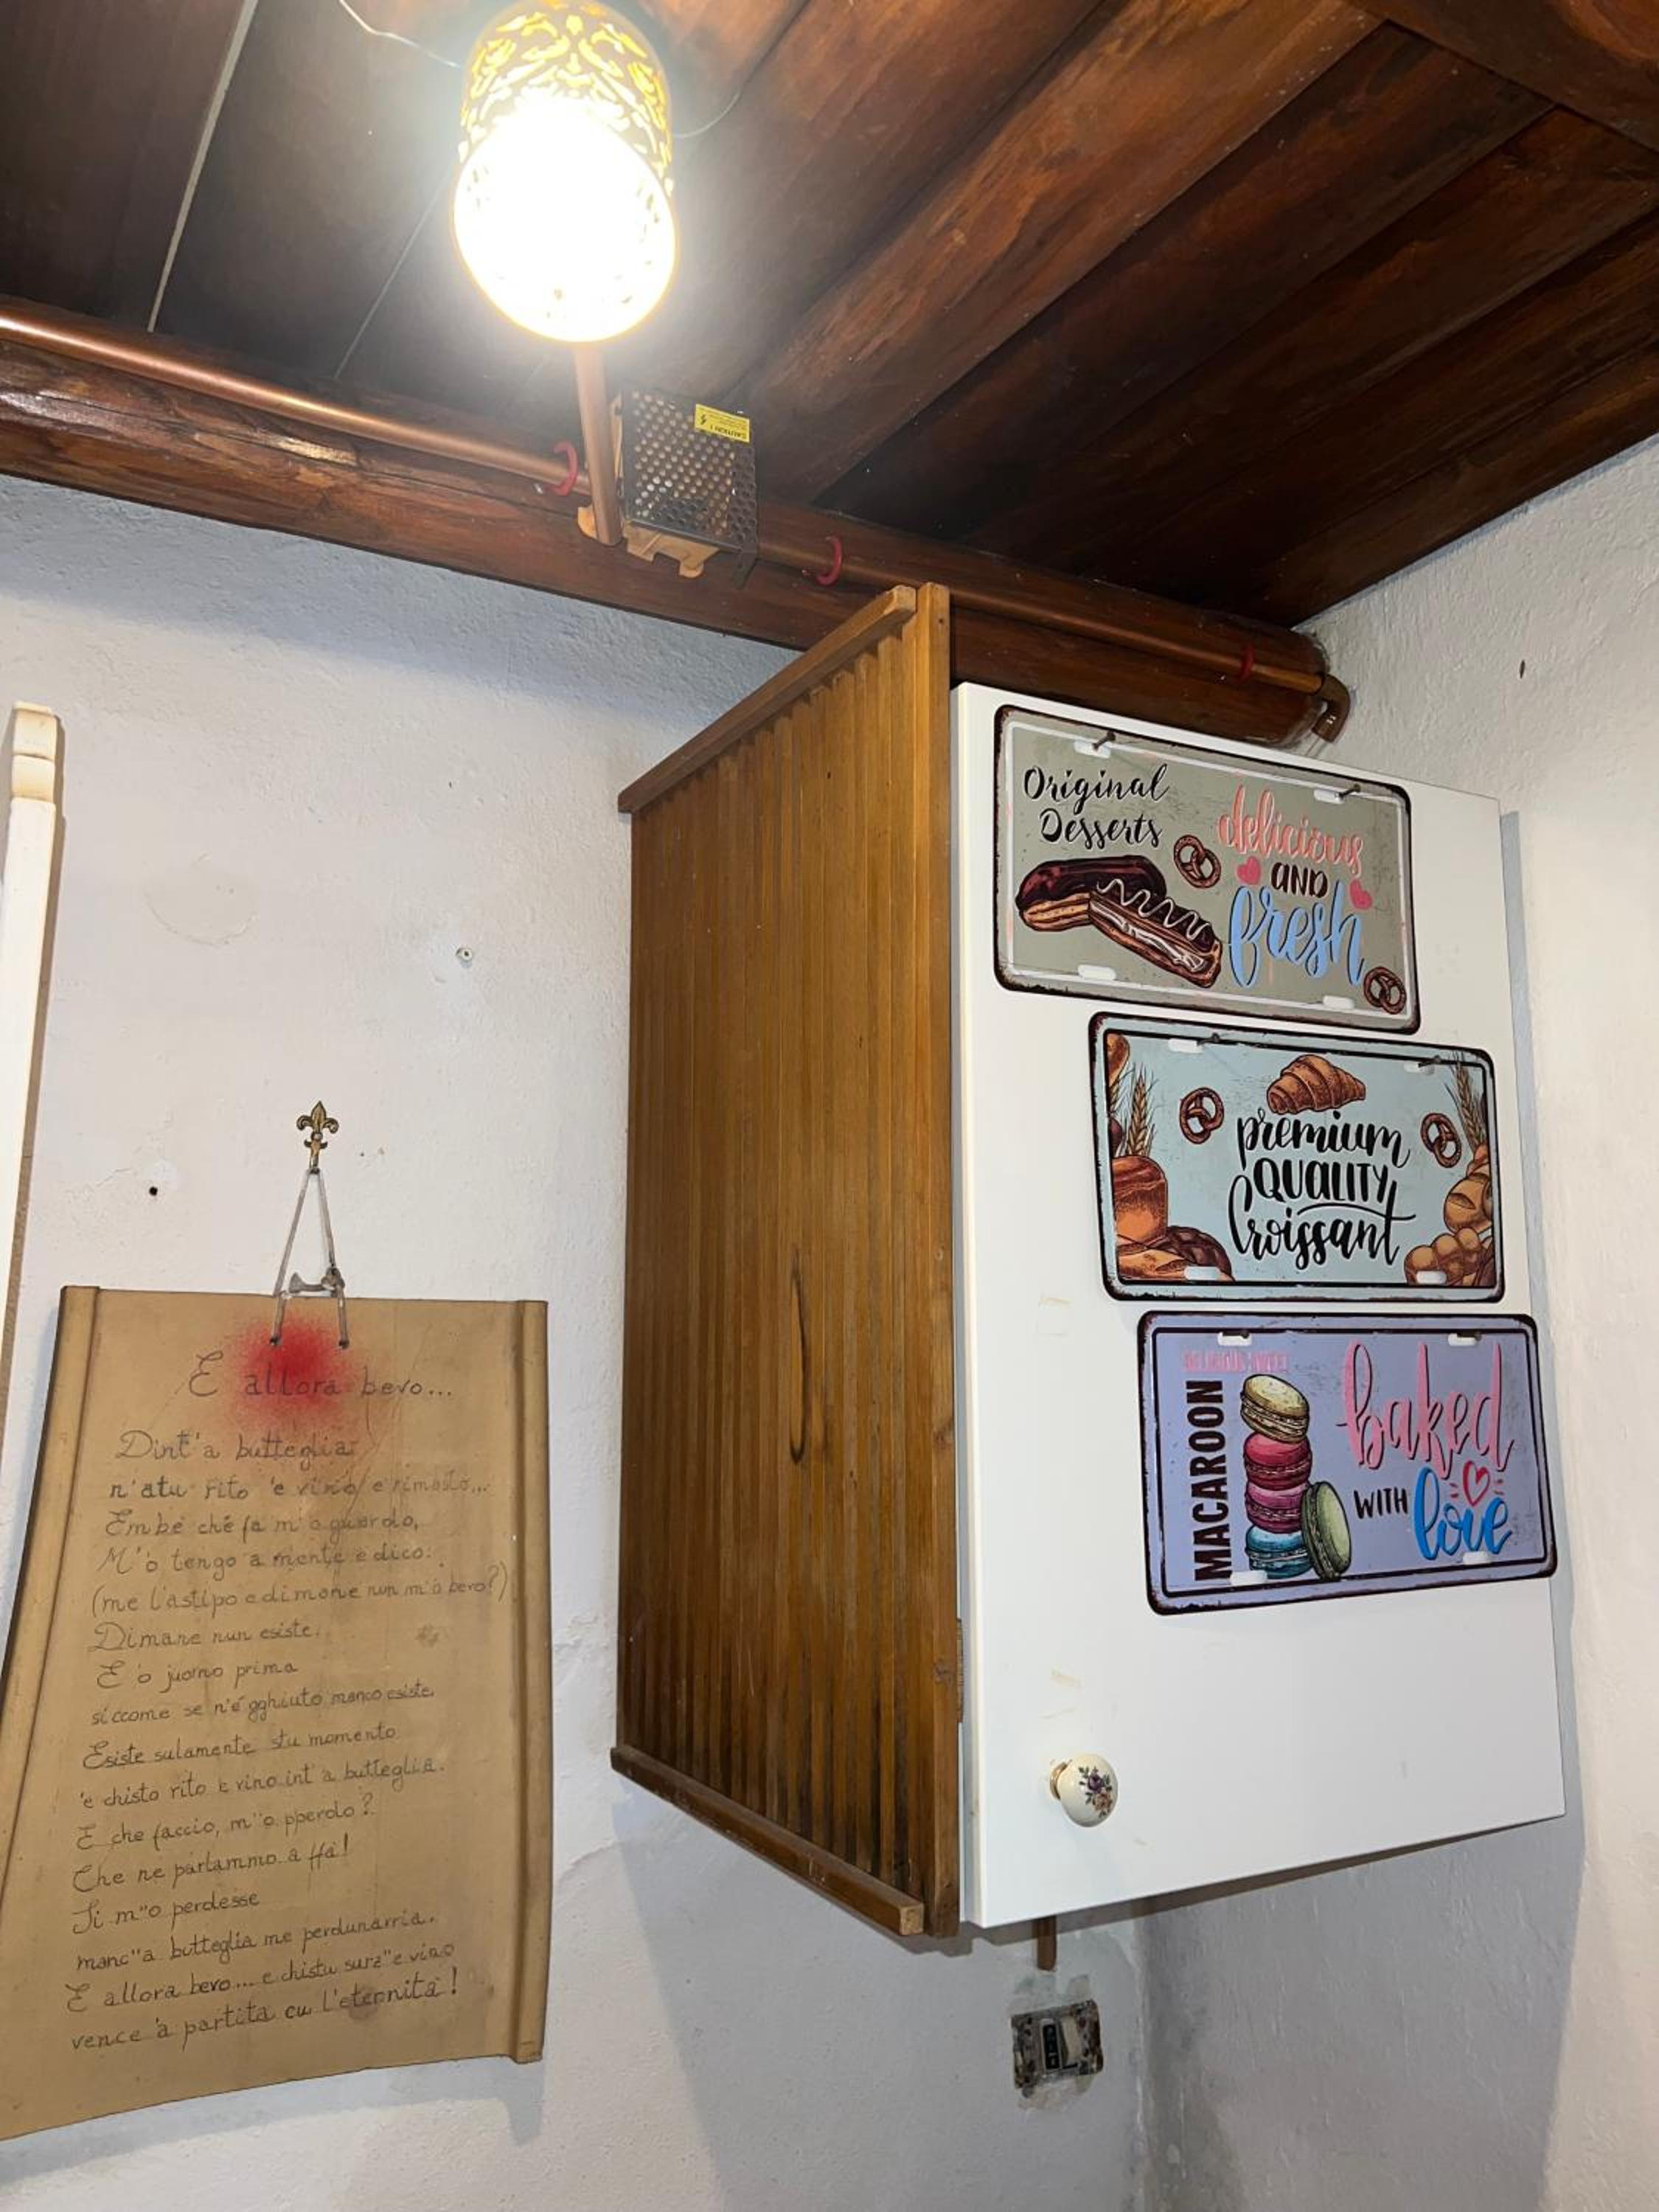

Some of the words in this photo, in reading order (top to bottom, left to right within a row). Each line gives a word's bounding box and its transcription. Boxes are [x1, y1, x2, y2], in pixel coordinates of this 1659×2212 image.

[1023, 762, 1169, 814] Original
[1038, 807, 1163, 849] Desserts
[1218, 784, 1364, 877] delicious
[1228, 880, 1366, 988] fresh
[1237, 1107, 1410, 1170] premium
[1228, 1175, 1416, 1270] Croissant
[244, 1366, 341, 1396] allora
[361, 1366, 451, 1395] bevo...
[1336, 1338, 1515, 1481] baked
[1186, 1380, 1232, 1582] MACAROON
[1353, 1488, 1408, 1518] WITH
[1412, 1467, 1512, 1561] love
[170, 1548, 237, 1581] tengo
[234, 1662, 298, 1689] prima
[91, 1708, 170, 1726] siccome
[153, 1734, 257, 1762] sulamente
[73, 1865, 125, 1892] Che
[138, 1867, 166, 1882] ne
[171, 1851, 279, 1889] parlammo
[170, 1891, 261, 1932] perdesse
[264, 1931, 293, 1947] me
[104, 1981, 180, 2007] allora
[72, 2030, 142, 2050] vence
[182, 2001, 276, 2052] partita
[285, 2004, 312, 2020] cu
